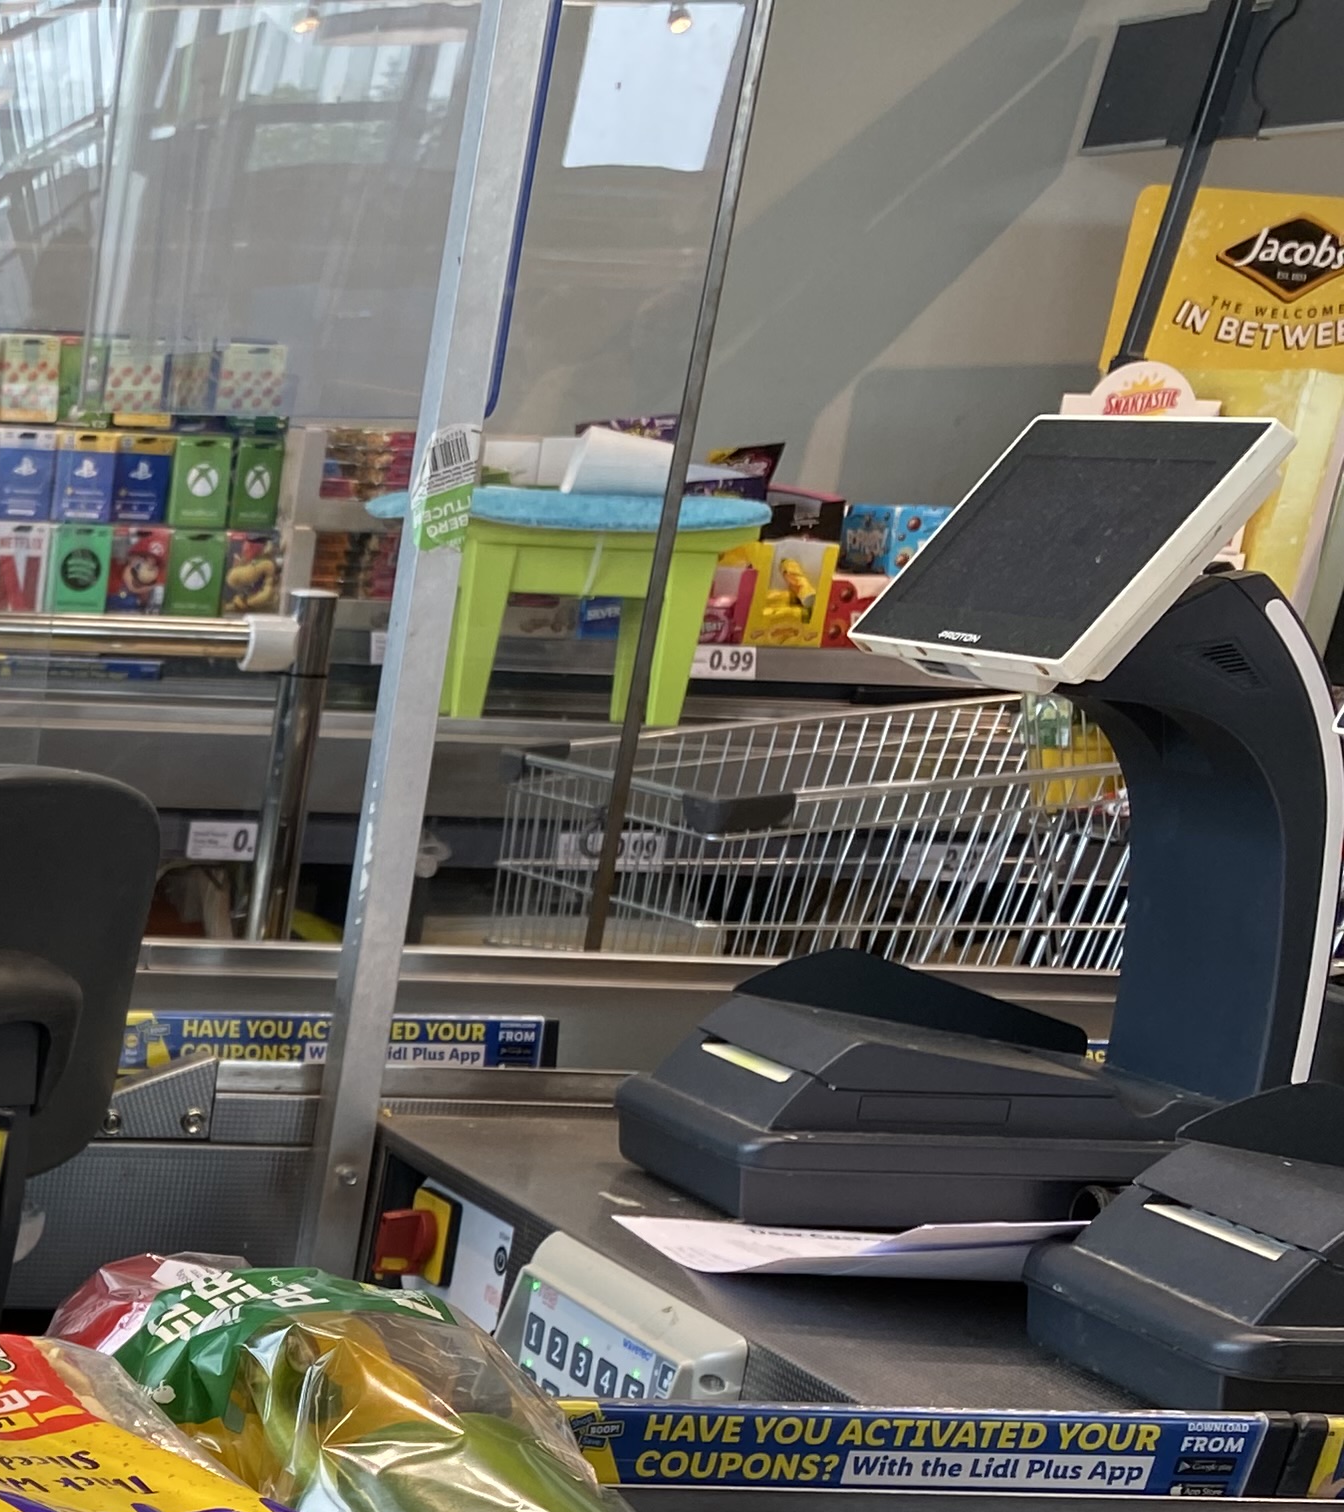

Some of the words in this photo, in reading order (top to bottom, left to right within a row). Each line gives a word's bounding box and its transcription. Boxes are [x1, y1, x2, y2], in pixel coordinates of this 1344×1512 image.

[1234, 227, 1344, 270] Jacobs
[1211, 295, 1243, 314] THE
[1173, 300, 1211, 335] IN
[1103, 388, 1181, 415] SNAKTASTIC
[0, 537, 43, 550] NETFLIX
[938, 630, 982, 643] PROTON
[709, 650, 753, 672] 0.99
[181, 1018, 243, 1039] HAVE
[246, 1019, 294, 1040] YOU
[426, 1021, 486, 1043] YOUR
[498, 1030, 536, 1043] FROM
[179, 1042, 301, 1061] COUPONS?
[387, 1044, 408, 1061] idl
[413, 1044, 446, 1063] Plus
[449, 1046, 481, 1065] App
[590, 1424, 621, 1436] BOOP!
[642, 1414, 745, 1443] HAVE
[753, 1416, 831, 1445] YOU
[837, 1419, 1048, 1449] ACTIVATED
[1059, 1423, 1161, 1451] YOUR
[1188, 1422, 1250, 1433] DOWNLOAD
[1180, 1436, 1246, 1453] FROM
[634, 1450, 840, 1481] COUPONS?
[852, 1455, 913, 1477] With
[921, 1457, 962, 1477] the
[969, 1458, 1018, 1479] Lidl
[1026, 1459, 1082, 1481] Plus
[1088, 1461, 1144, 1486] App
[58, 1474, 160, 1495] Thick
